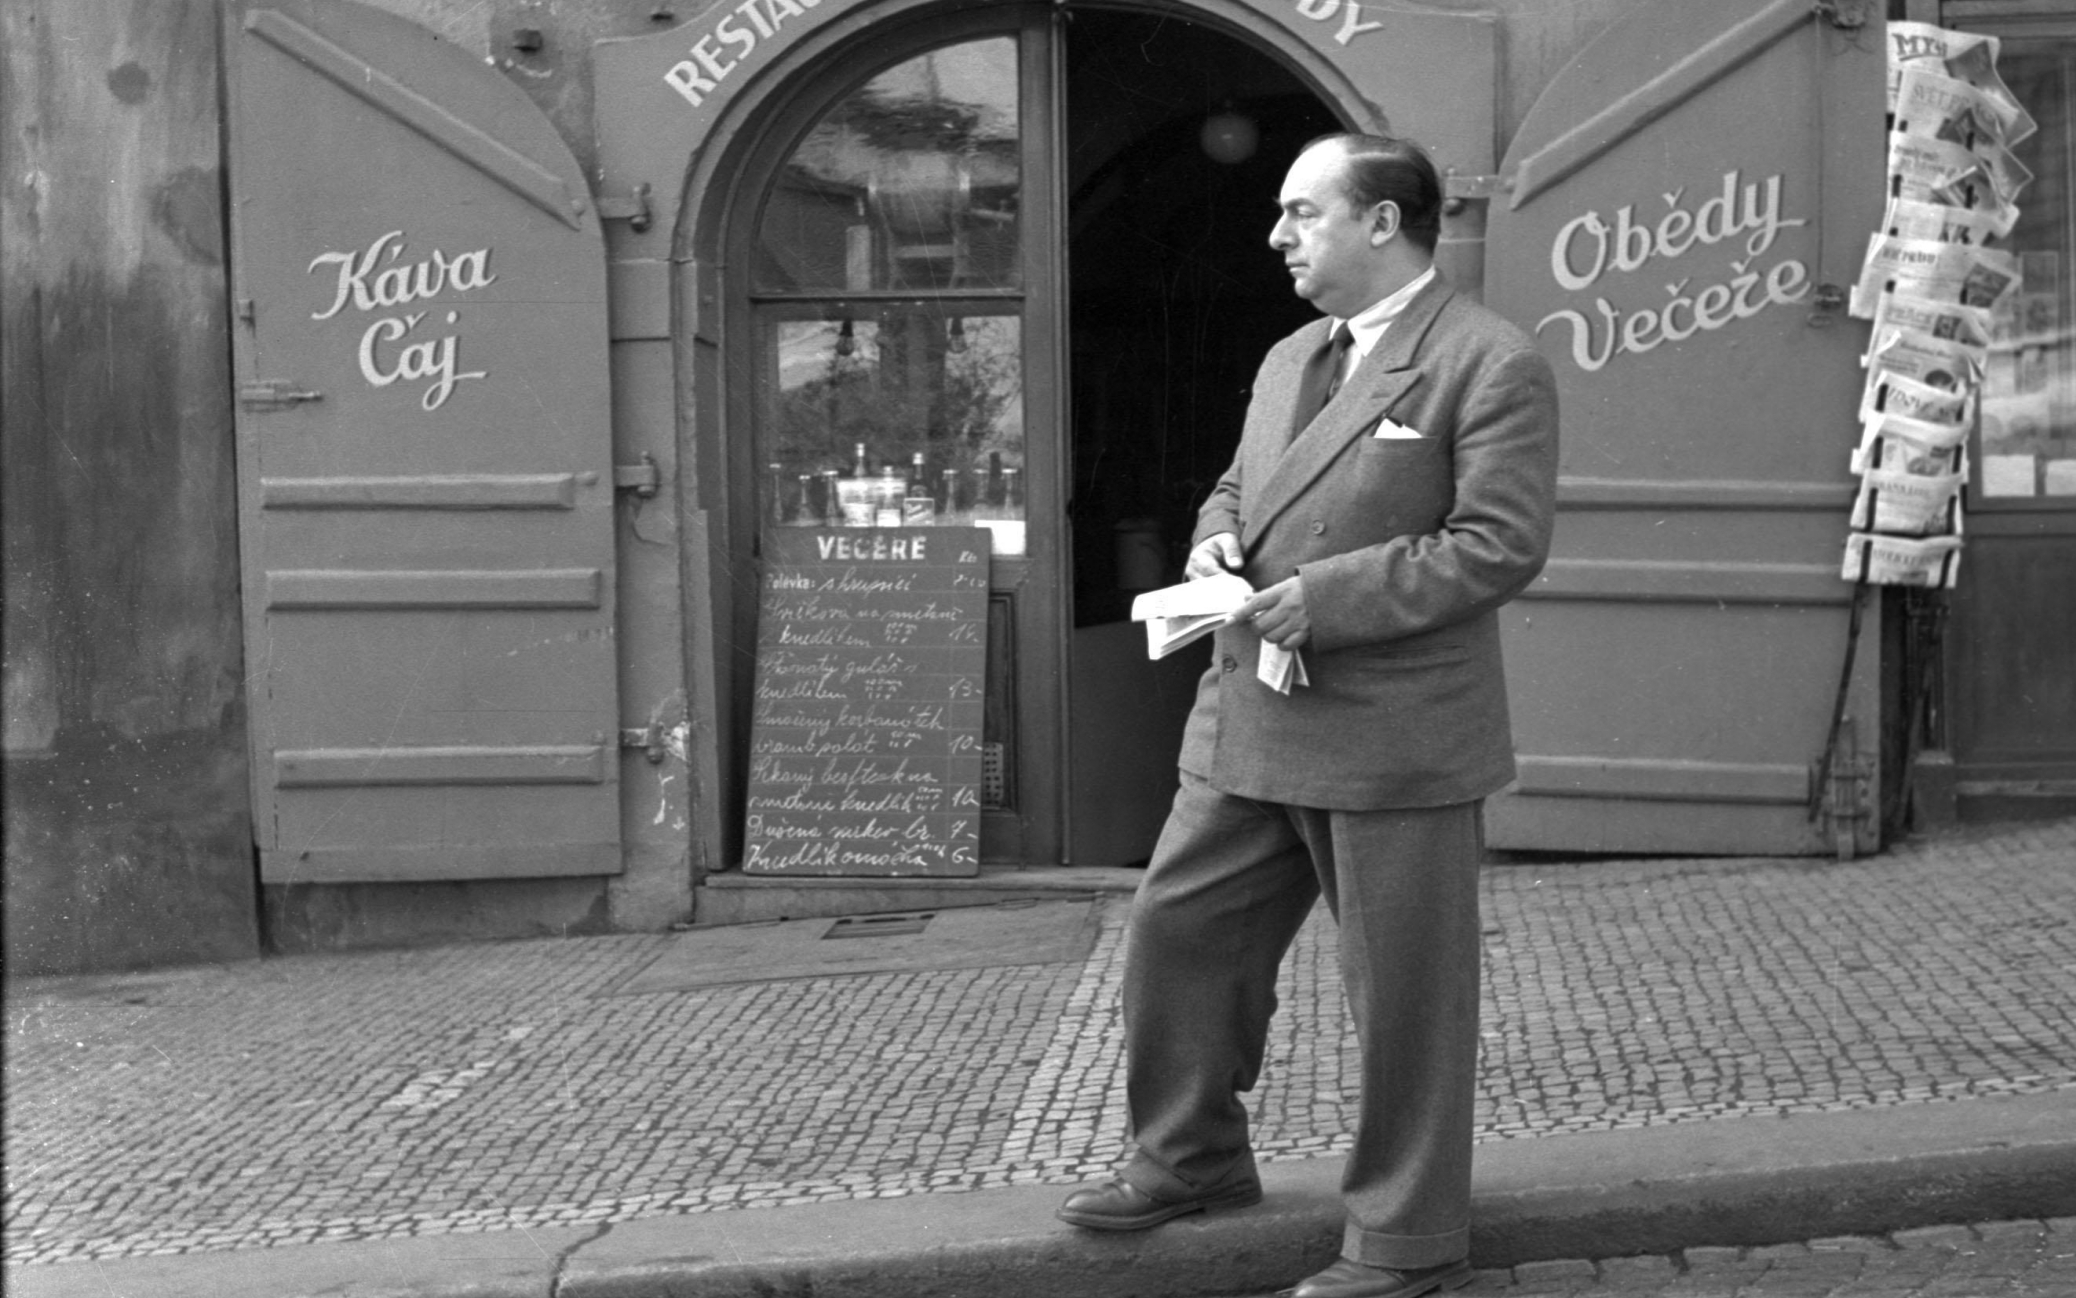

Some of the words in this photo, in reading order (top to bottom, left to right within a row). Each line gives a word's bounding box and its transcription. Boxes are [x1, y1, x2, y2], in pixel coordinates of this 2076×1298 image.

[664, 0, 822, 107] RESTA
[307, 230, 497, 319] Káva
[1552, 170, 1806, 290] Obědy
[359, 311, 487, 411] Čaj
[1536, 256, 1811, 371] Večeře
